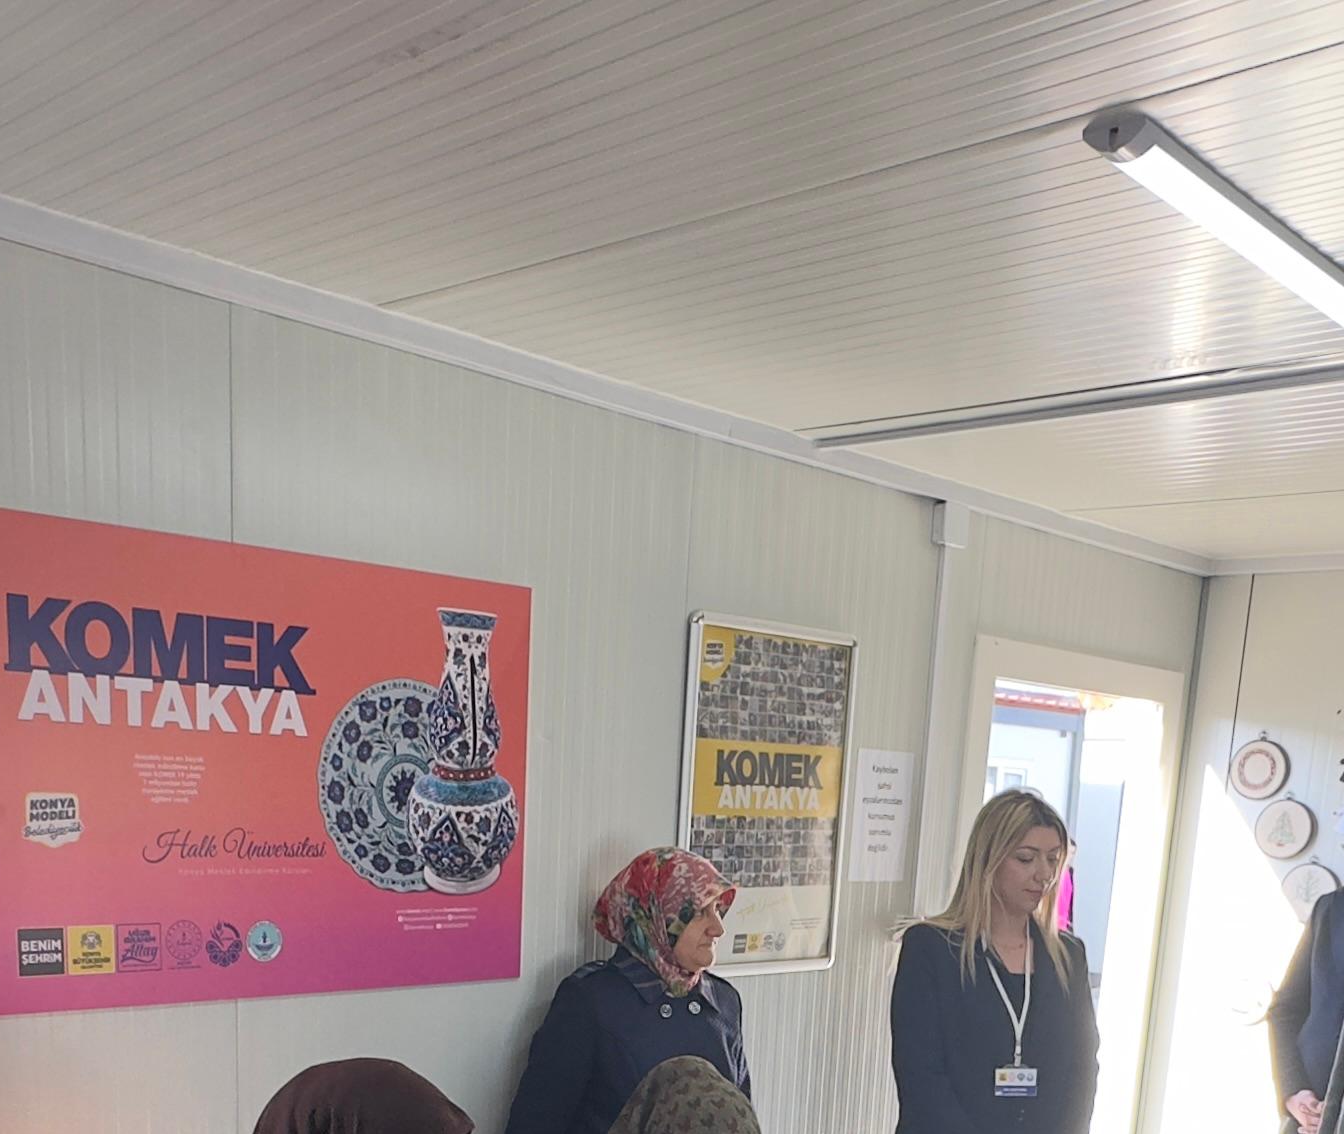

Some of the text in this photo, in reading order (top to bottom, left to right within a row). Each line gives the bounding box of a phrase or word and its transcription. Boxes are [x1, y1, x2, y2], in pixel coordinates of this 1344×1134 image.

[4, 592, 317, 695] KOMEK
[17, 668, 309, 737] ANTAKYA
[714, 749, 824, 790] KOMEK
[29, 798, 76, 811] KONYA
[717, 785, 821, 810] ANTAKYA
[142, 827, 327, 864] Halk Üniversitesi
